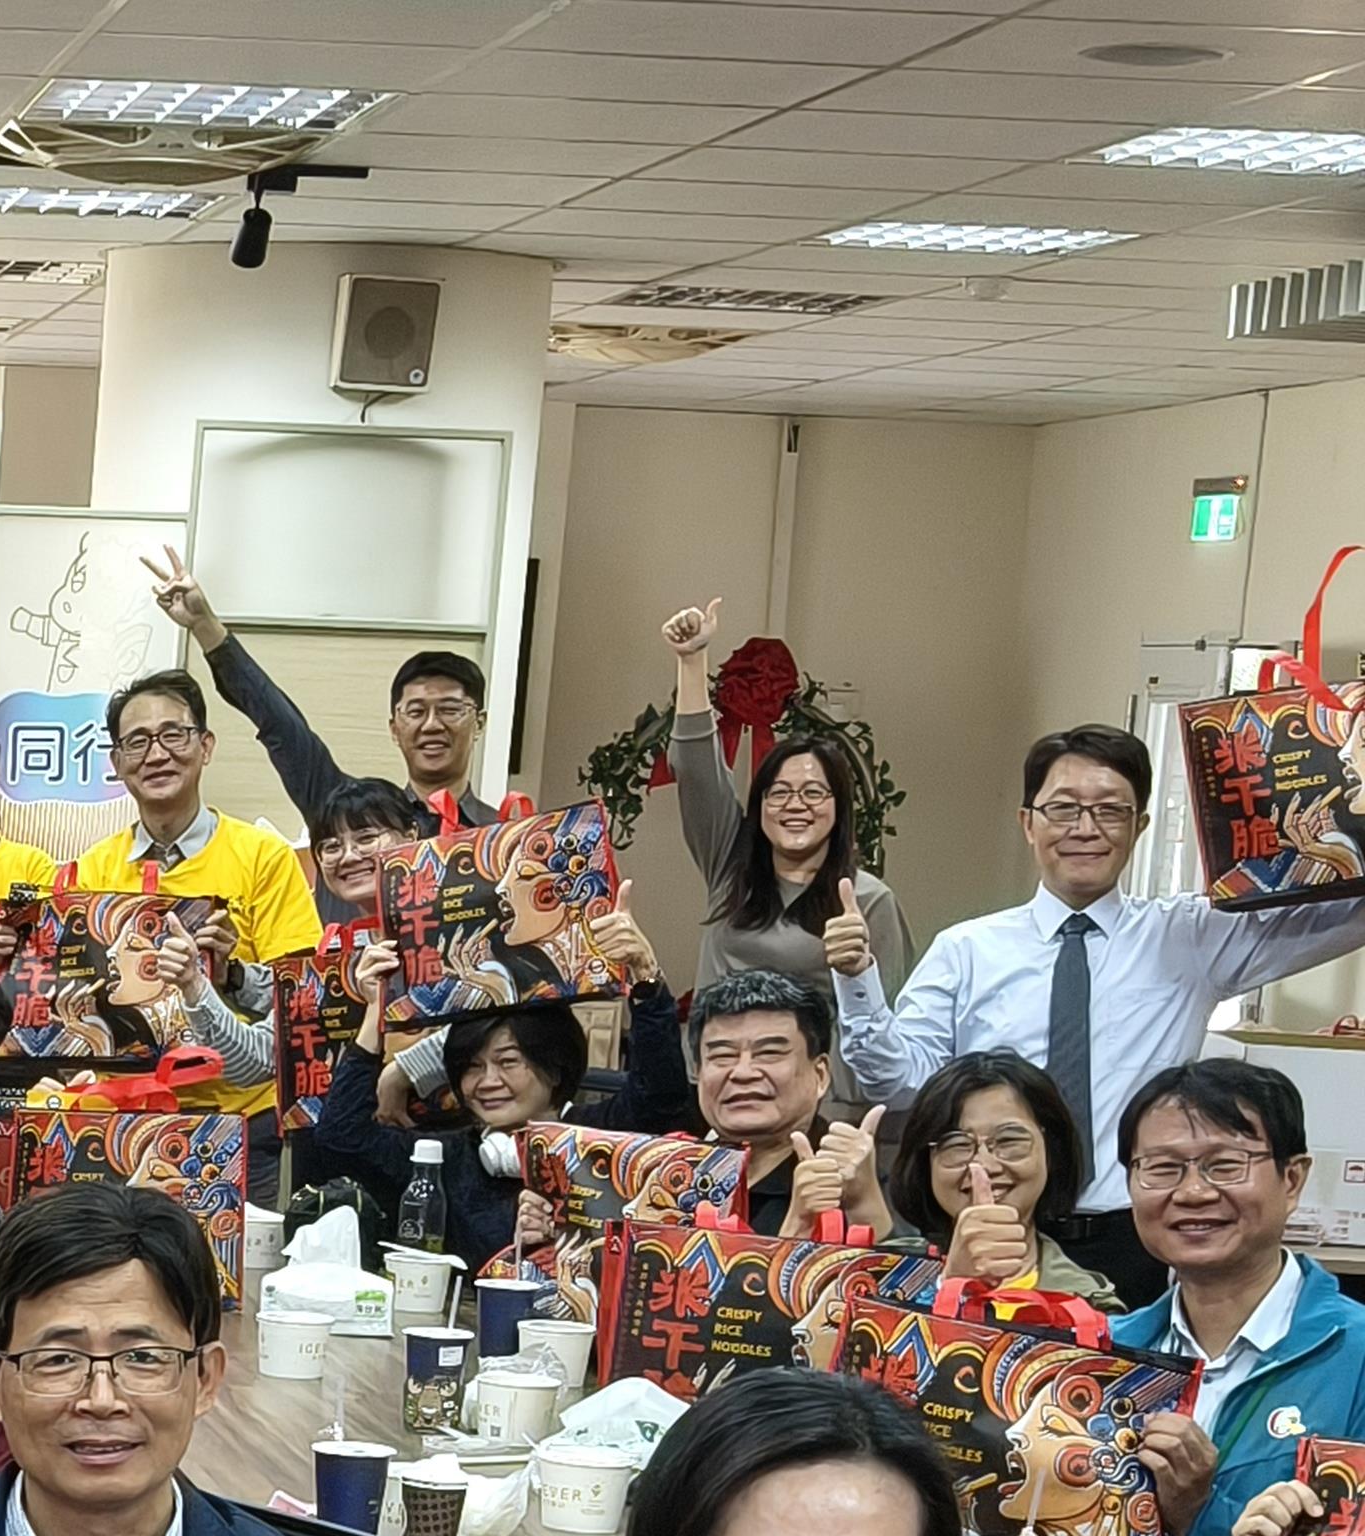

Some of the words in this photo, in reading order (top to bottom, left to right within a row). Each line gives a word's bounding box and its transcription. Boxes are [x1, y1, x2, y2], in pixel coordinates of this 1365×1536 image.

[717, 1307, 763, 1323] CRISPY
[714, 1324, 743, 1336] RICE
[711, 1341, 772, 1357] NOODLES
[923, 1402, 974, 1422] CRISPY
